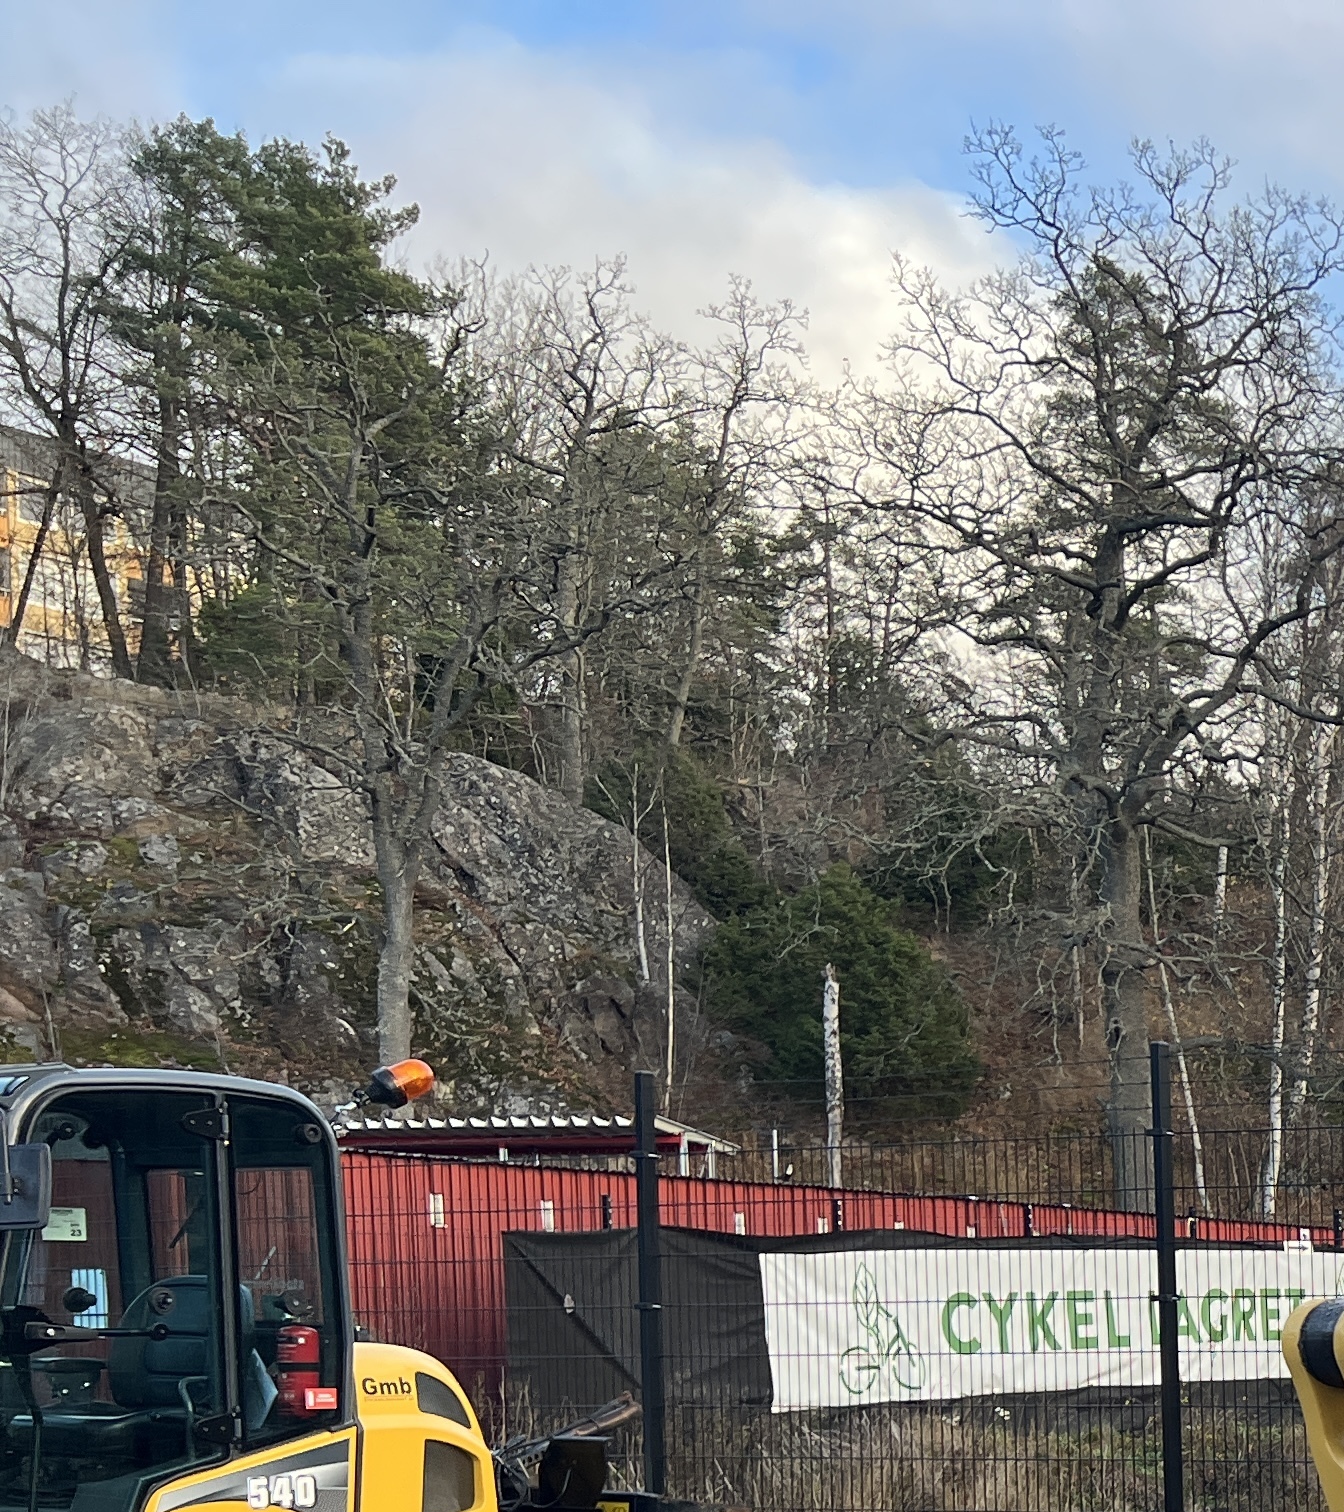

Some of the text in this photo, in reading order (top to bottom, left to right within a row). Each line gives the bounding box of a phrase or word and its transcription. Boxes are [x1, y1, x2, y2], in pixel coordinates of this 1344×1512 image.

[941, 1290, 1131, 1355] CYKEL
[361, 1377, 412, 1395] Gmb
[247, 1475, 317, 1509] 540
